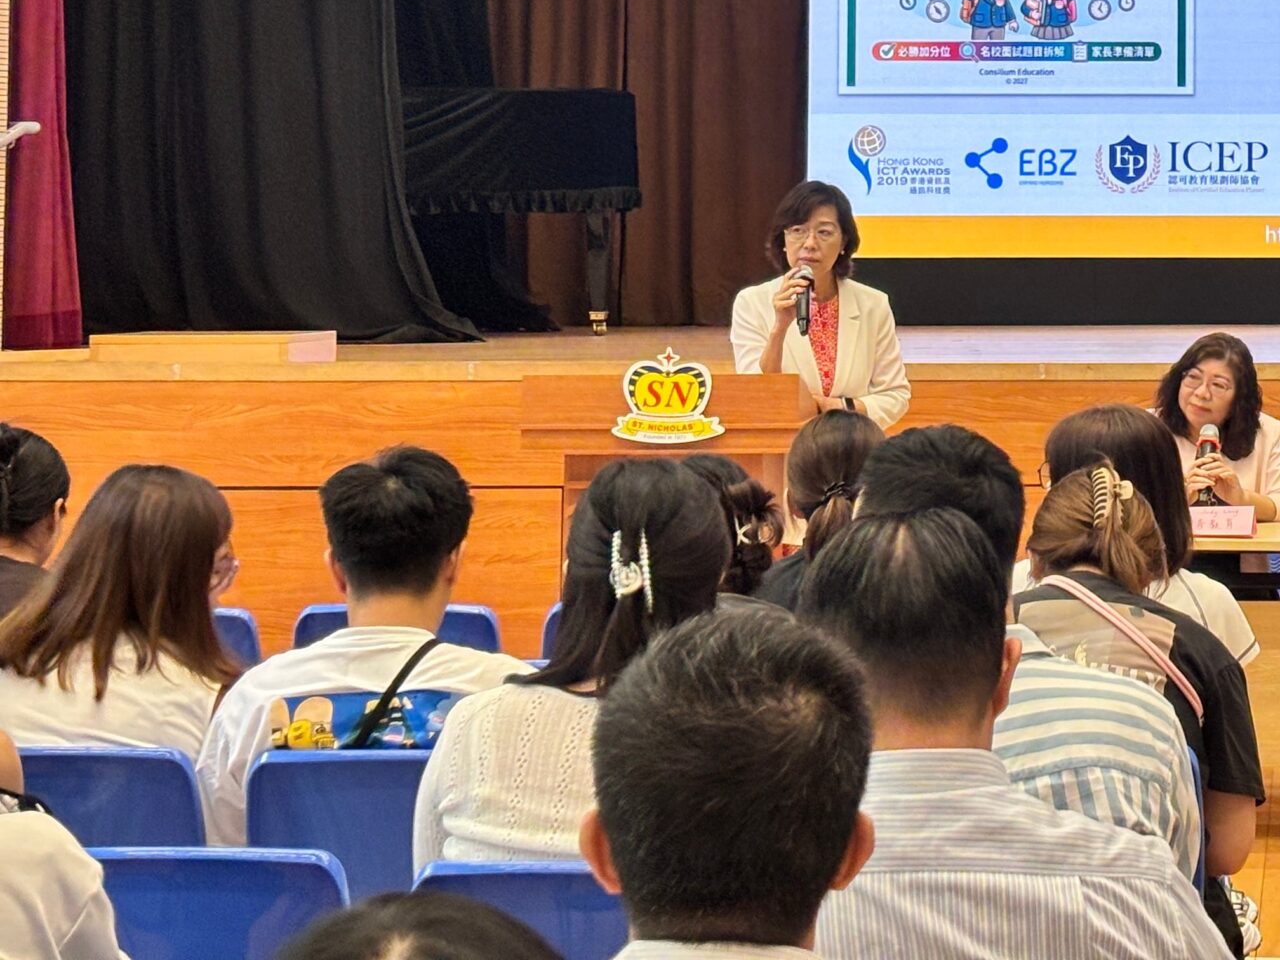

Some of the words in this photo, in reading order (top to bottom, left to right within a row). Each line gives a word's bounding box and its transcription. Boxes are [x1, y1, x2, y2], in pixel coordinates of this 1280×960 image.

[979, 68, 1016, 76] Consilium
[1017, 68, 1055, 76] Education
[1168, 140, 1269, 173] ICEP
[877, 157, 910, 166] HONG
[912, 157, 944, 166] KONG
[1019, 148, 1077, 177] EBZ
[877, 167, 898, 176] ICT
[901, 167, 951, 176] AWARDS
[877, 176, 908, 186] 2019
[642, 380, 695, 409] SN
[631, 421, 645, 430] ST.
